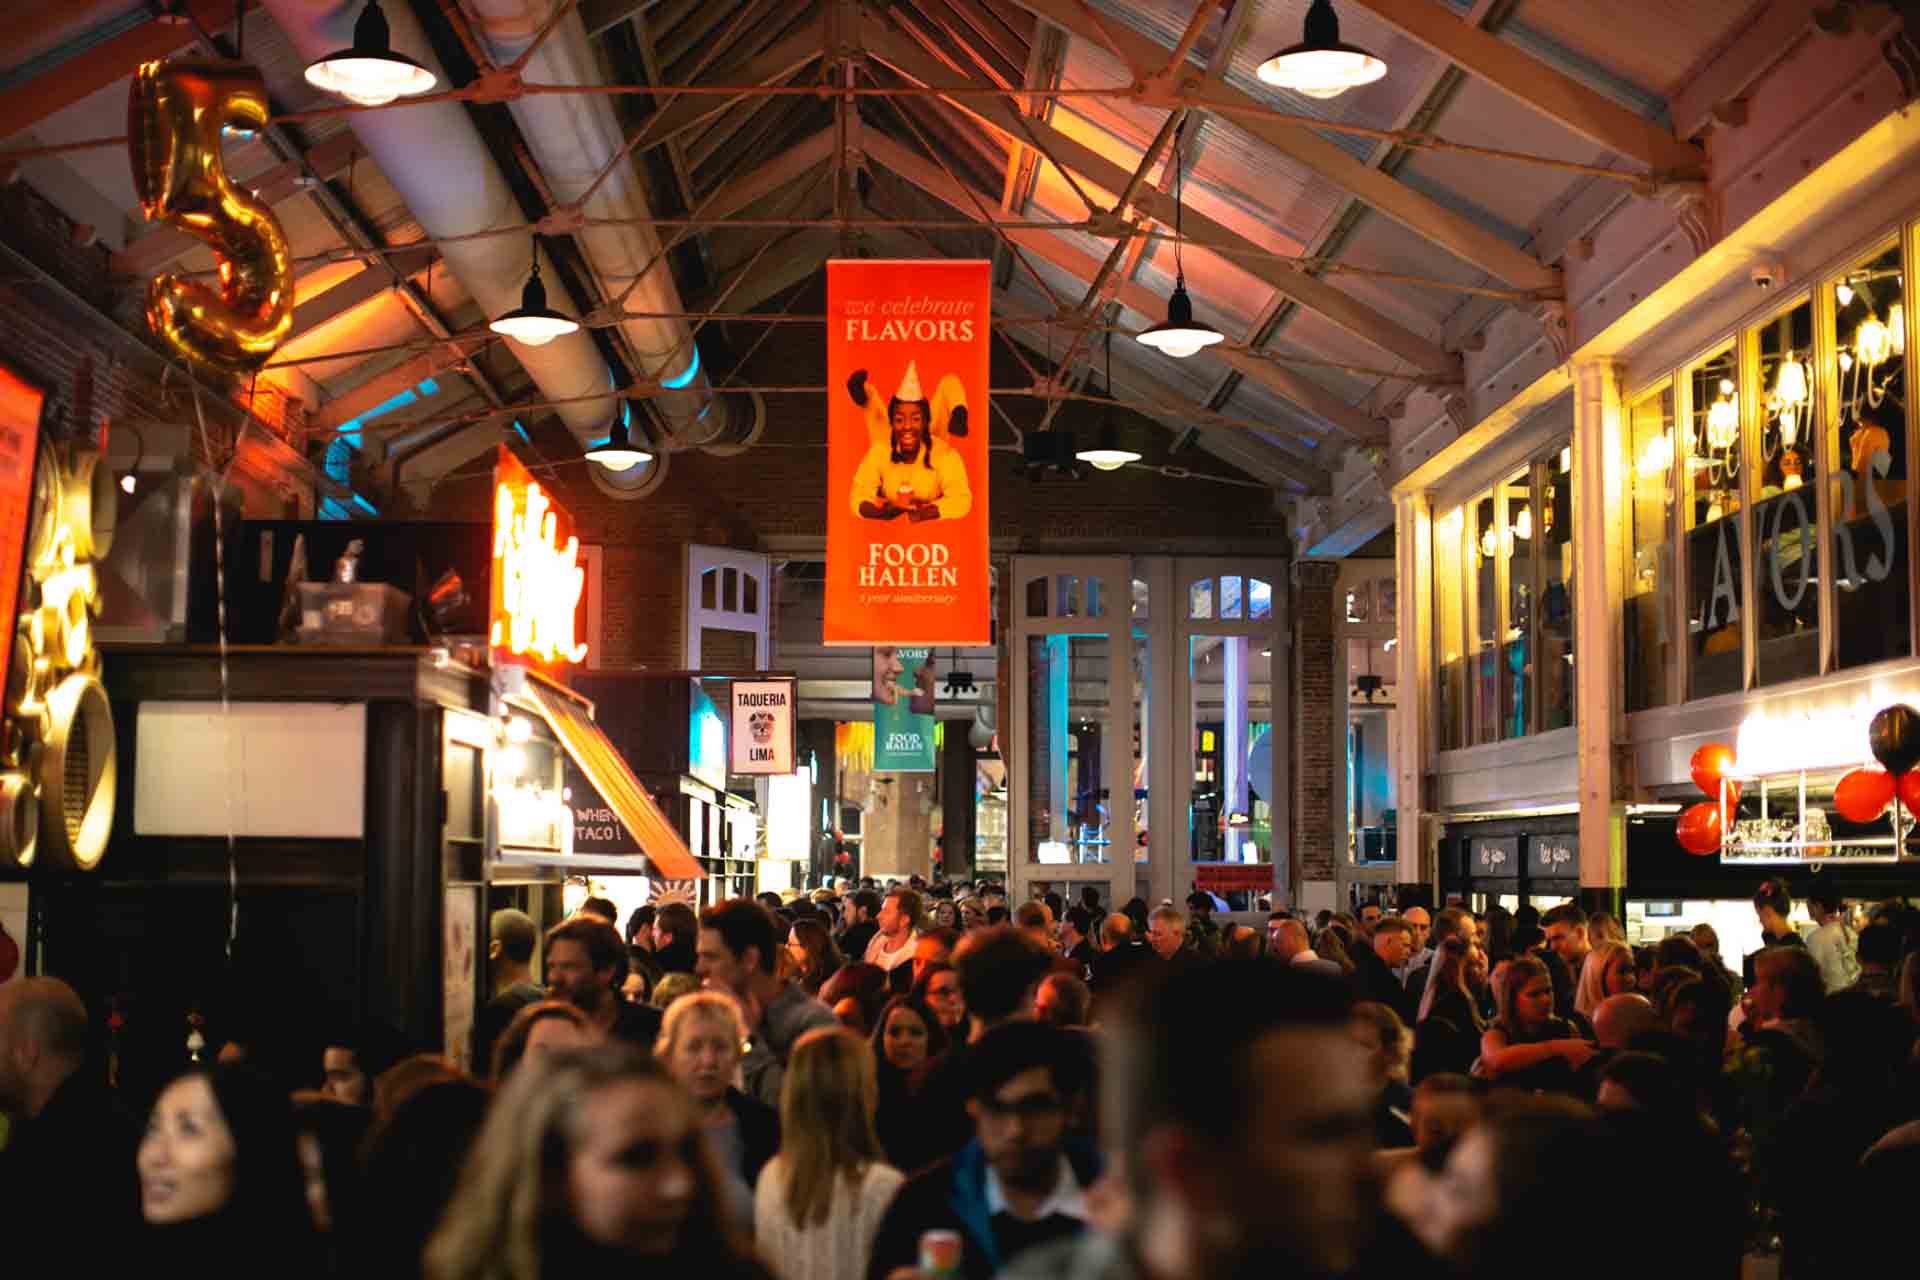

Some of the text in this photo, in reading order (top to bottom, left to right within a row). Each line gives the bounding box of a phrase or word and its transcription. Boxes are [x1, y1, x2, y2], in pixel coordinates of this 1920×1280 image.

[128, 60, 296, 370] 5
[846, 296, 975, 315] we celebrate
[846, 320, 975, 342] FLAVORS
[868, 543, 950, 566] FOOD
[859, 567, 958, 587] HALLEN
[896, 648, 928, 658] VORS
[737, 693, 786, 706] TAQUERIA
[889, 733, 920, 743] FOOD
[749, 748, 775, 761] LIMA
